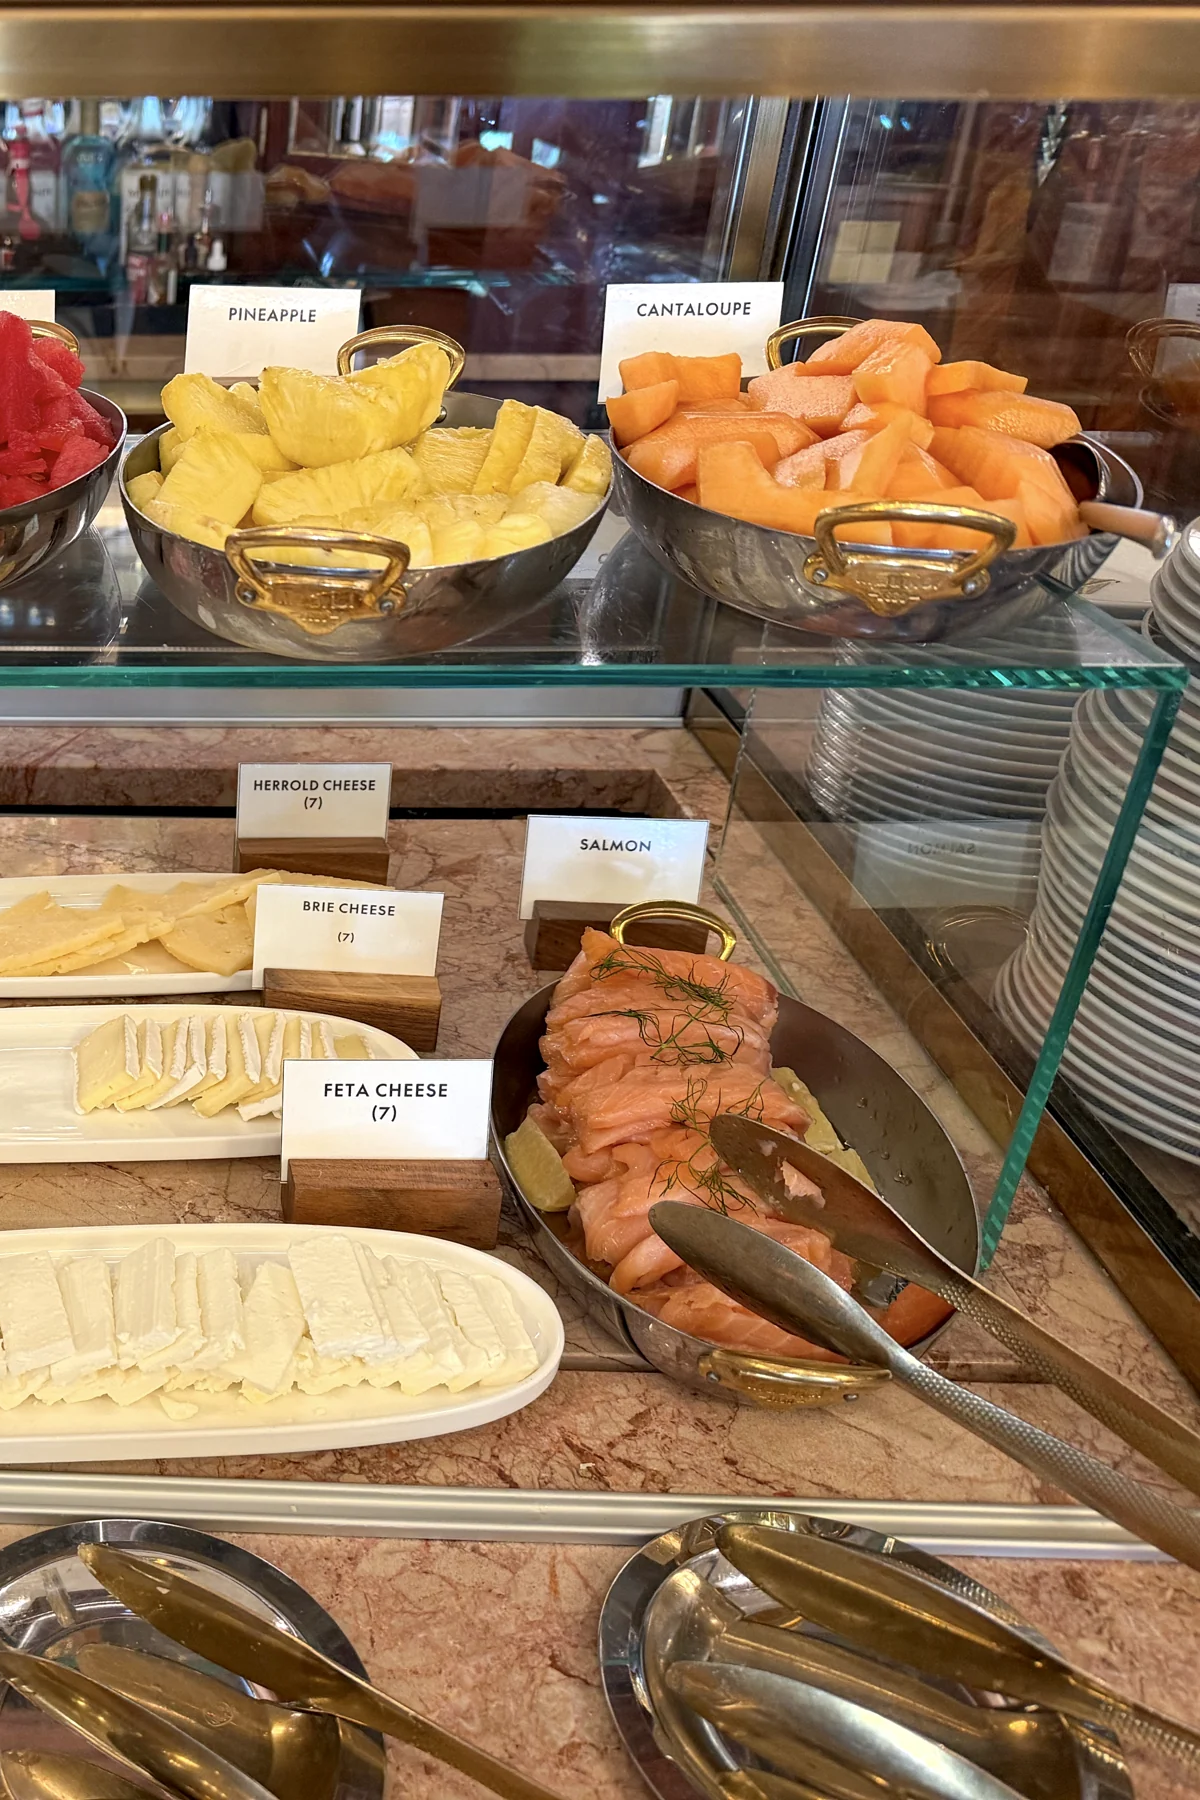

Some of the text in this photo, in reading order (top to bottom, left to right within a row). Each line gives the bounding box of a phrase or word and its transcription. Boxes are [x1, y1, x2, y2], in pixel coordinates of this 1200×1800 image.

[228, 307, 317, 323] PINEAPPLE
[636, 301, 752, 317] CANTALOUPE
[253, 779, 376, 792] HERROLD CHEESE
[303, 795, 323, 811] (7)
[579, 838, 652, 853] SALMON
[302, 900, 396, 917] BRIE CHEESE
[337, 931, 355, 944] (7)
[323, 1082, 448, 1098] FETA CHEESE
[371, 1104, 397, 1123] (7)
